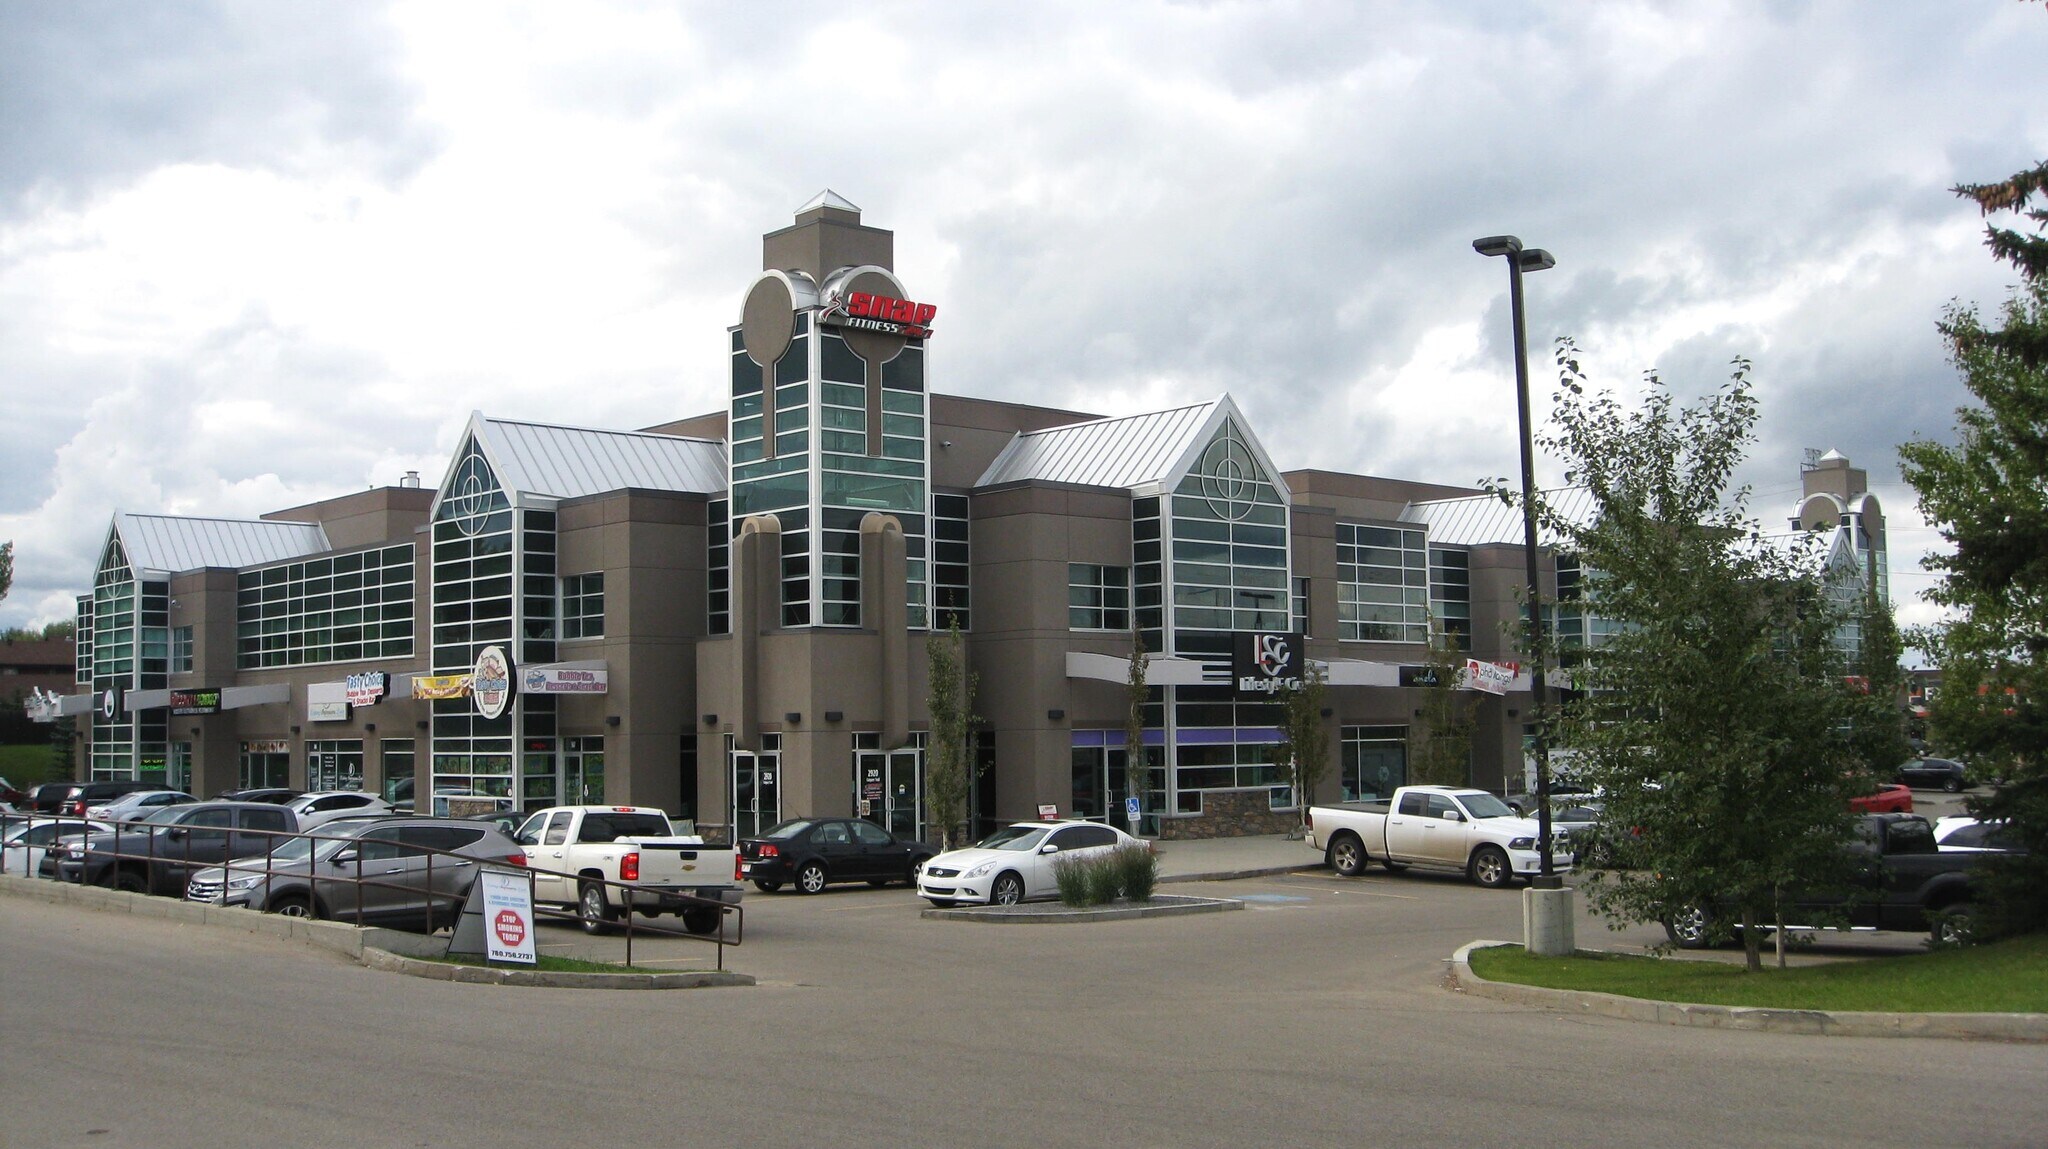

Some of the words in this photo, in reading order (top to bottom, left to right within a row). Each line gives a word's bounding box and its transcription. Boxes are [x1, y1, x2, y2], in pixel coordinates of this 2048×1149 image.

[846, 317, 899, 333] FITNESS
[347, 674, 364, 690] Tasty
[364, 672, 384, 687] Choice
[502, 915, 517, 923] STOP
[497, 923, 522, 933] SMOKING
[502, 933, 519, 941] TODAY
